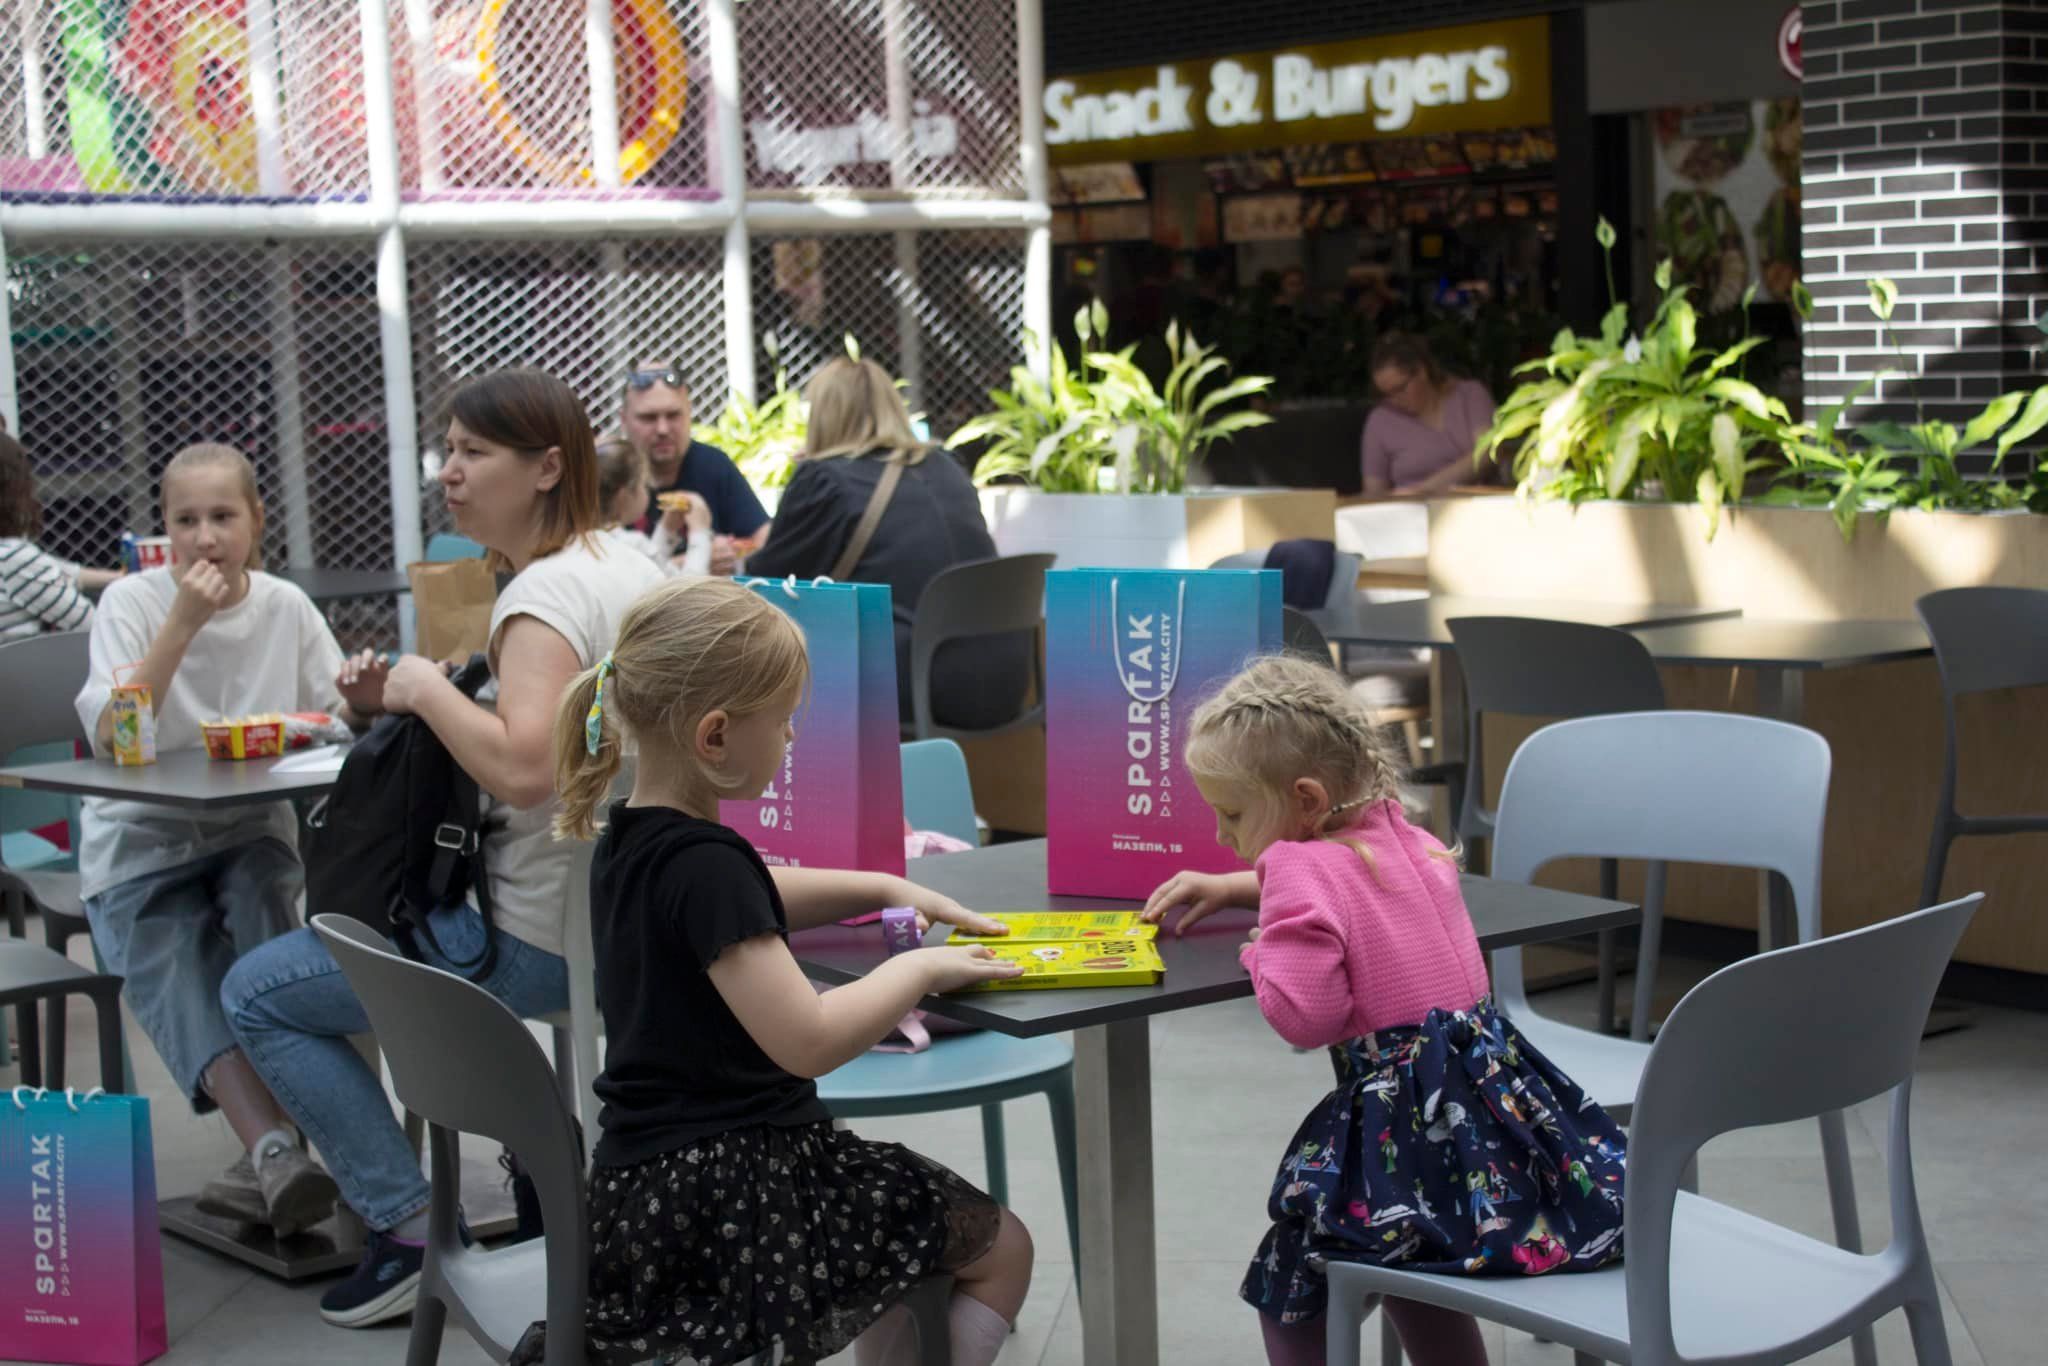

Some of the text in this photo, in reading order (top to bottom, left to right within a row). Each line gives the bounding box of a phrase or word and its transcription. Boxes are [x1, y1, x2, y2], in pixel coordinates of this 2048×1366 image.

[1043, 66, 1194, 143] Snack
[1207, 60, 1262, 127] &
[1273, 46, 1511, 131] Burgers
